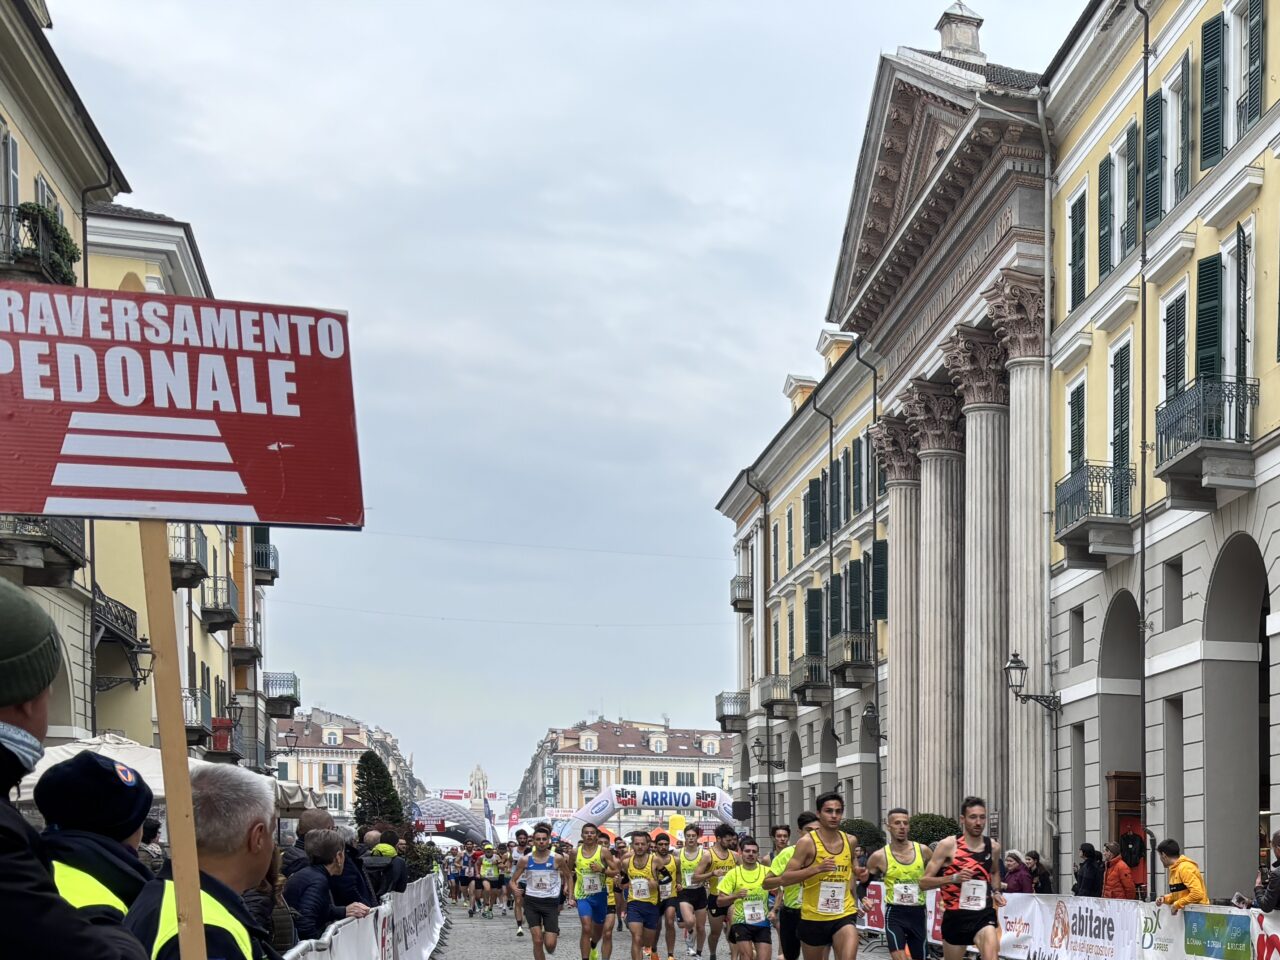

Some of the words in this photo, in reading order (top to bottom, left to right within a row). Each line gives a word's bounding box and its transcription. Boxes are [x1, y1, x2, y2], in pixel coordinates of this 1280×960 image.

[641, 790, 691, 807] ARRIVO
[830, 889, 836, 898] 3
[1071, 906, 1115, 941] abitare
